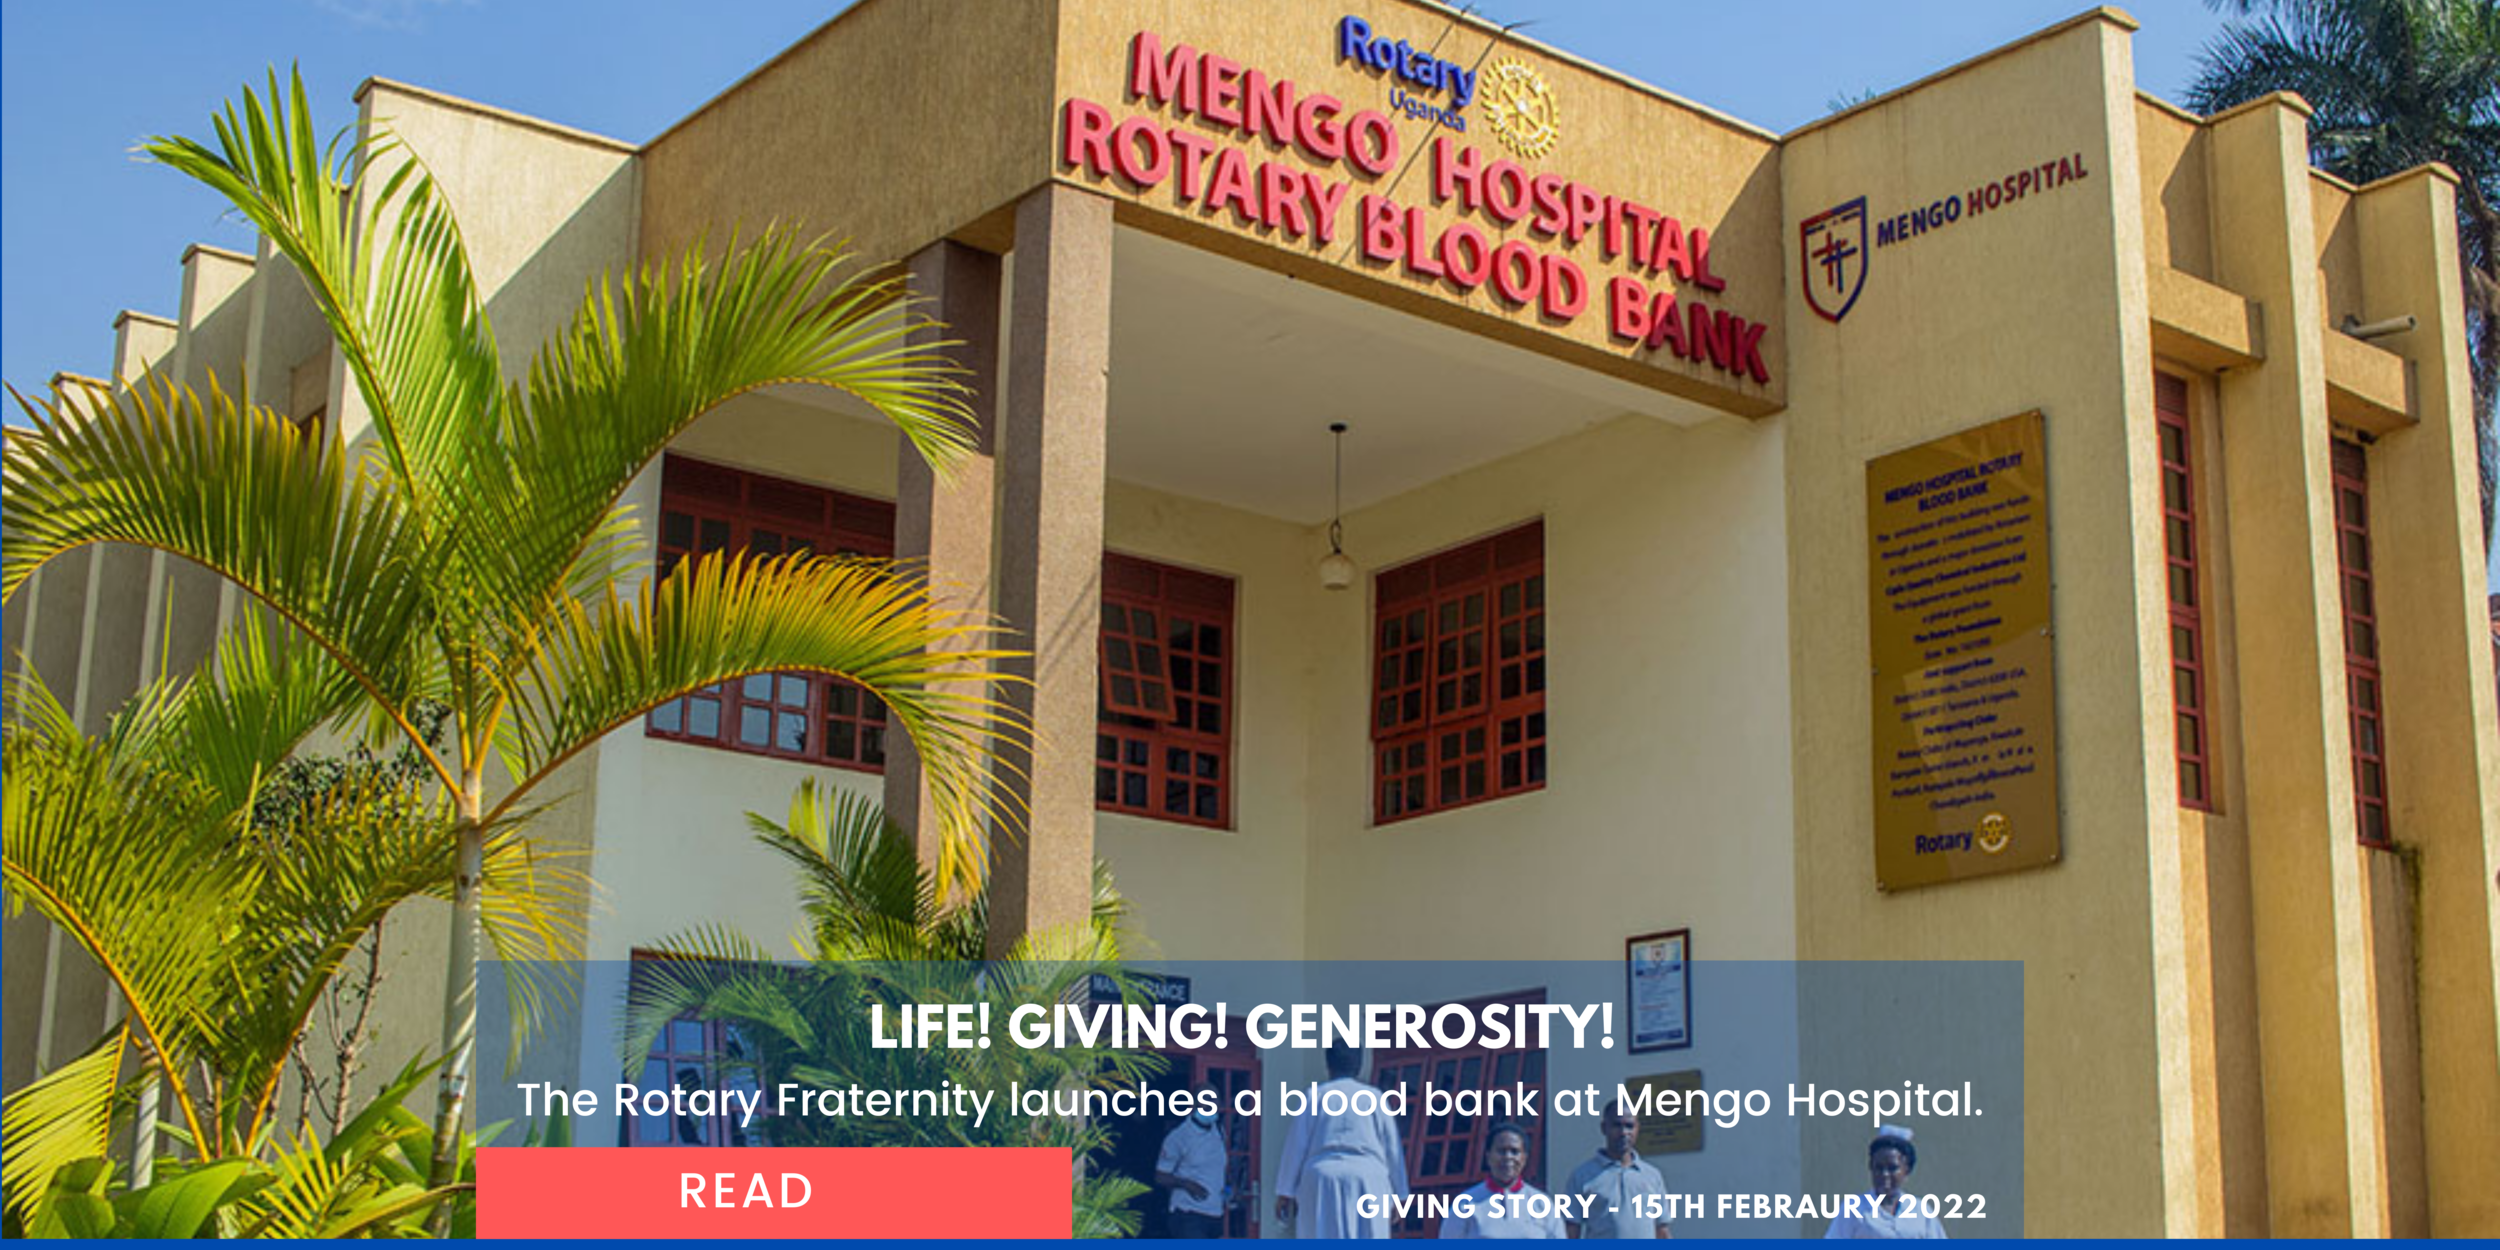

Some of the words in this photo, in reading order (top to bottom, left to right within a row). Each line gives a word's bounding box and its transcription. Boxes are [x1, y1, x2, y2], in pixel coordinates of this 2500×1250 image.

[1340, 15, 1476, 107] Rotary
[1389, 87, 1467, 132] Uganda
[1131, 30, 1401, 177] MENGO
[1433, 136, 1726, 292] HOSPITAL
[1877, 195, 1962, 248] MENGO
[1967, 152, 2089, 218] HOSPITAL
[1064, 97, 1349, 244] ROTARY
[1362, 193, 1589, 320] BLOOD
[1609, 275, 1770, 384] BANK
[1885, 481, 1924, 503] MENGO
[1925, 466, 1977, 489] HOSPITAL
[1979, 452, 2022, 475] ROTARY
[1918, 490, 1956, 511] BLOOD
[1957, 480, 1988, 501] BANK
[1915, 829, 1975, 856] Rotary
